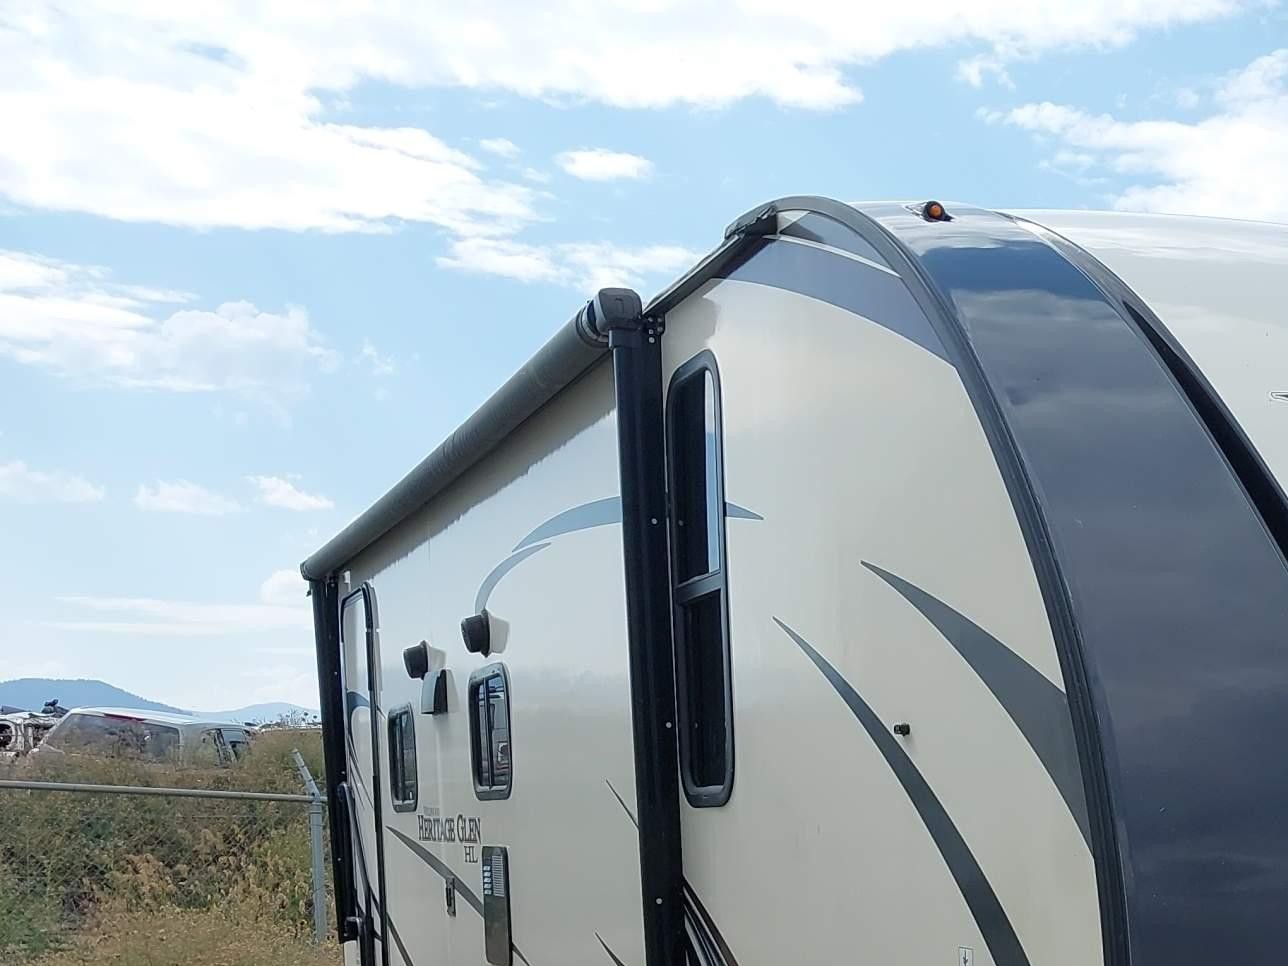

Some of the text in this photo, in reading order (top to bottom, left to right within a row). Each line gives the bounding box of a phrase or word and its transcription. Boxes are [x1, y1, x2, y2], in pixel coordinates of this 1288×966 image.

[417, 814, 482, 845] HERITAGE GLEN
[463, 845, 479, 863] HL
